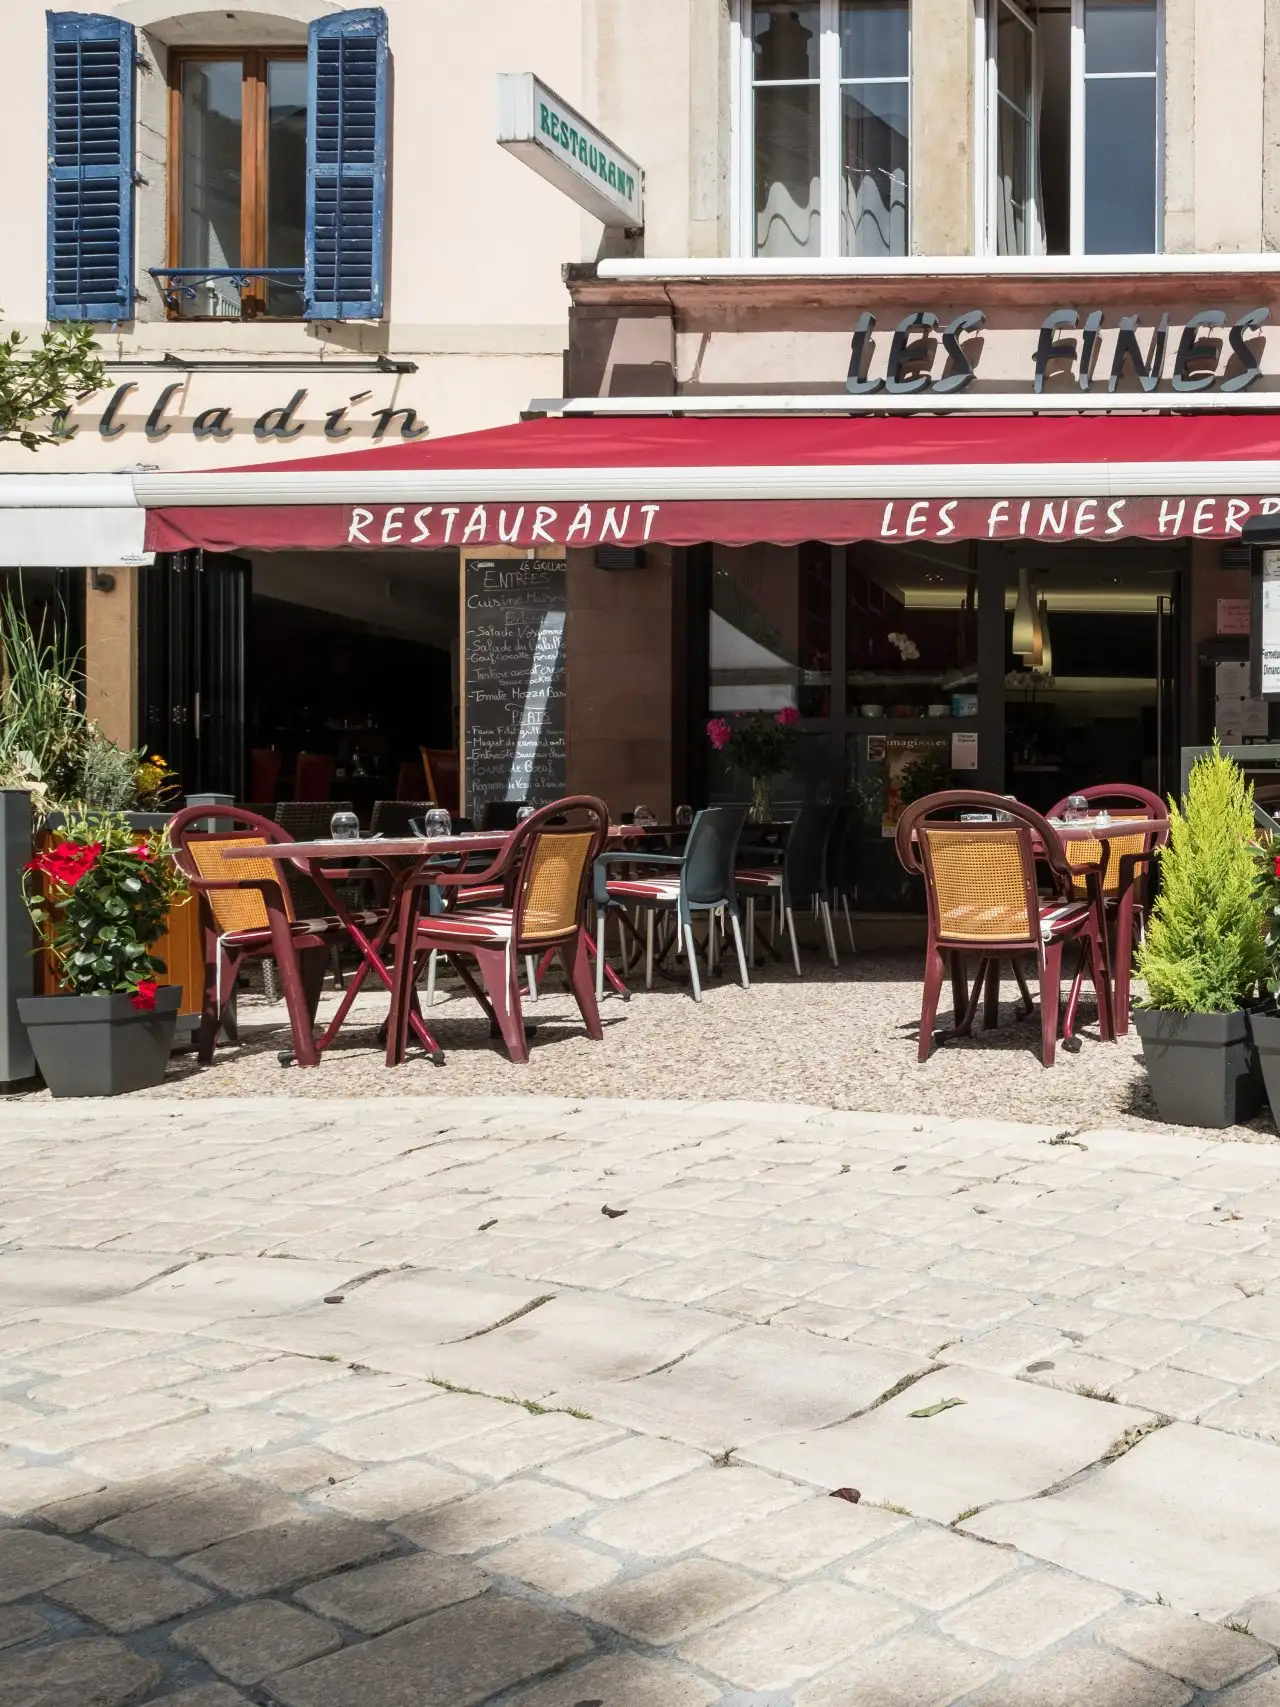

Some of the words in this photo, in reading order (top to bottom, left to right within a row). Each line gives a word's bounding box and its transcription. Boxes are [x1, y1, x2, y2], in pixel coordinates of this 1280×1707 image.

[540, 102, 635, 202] RESTAURANT
[846, 308, 987, 394] LES
[1031, 306, 1271, 394] FINES
[0, 380, 430, 440] illadin
[347, 503, 660, 544] RESTAURANT
[880, 499, 958, 537] LES
[987, 498, 1127, 538] FINES
